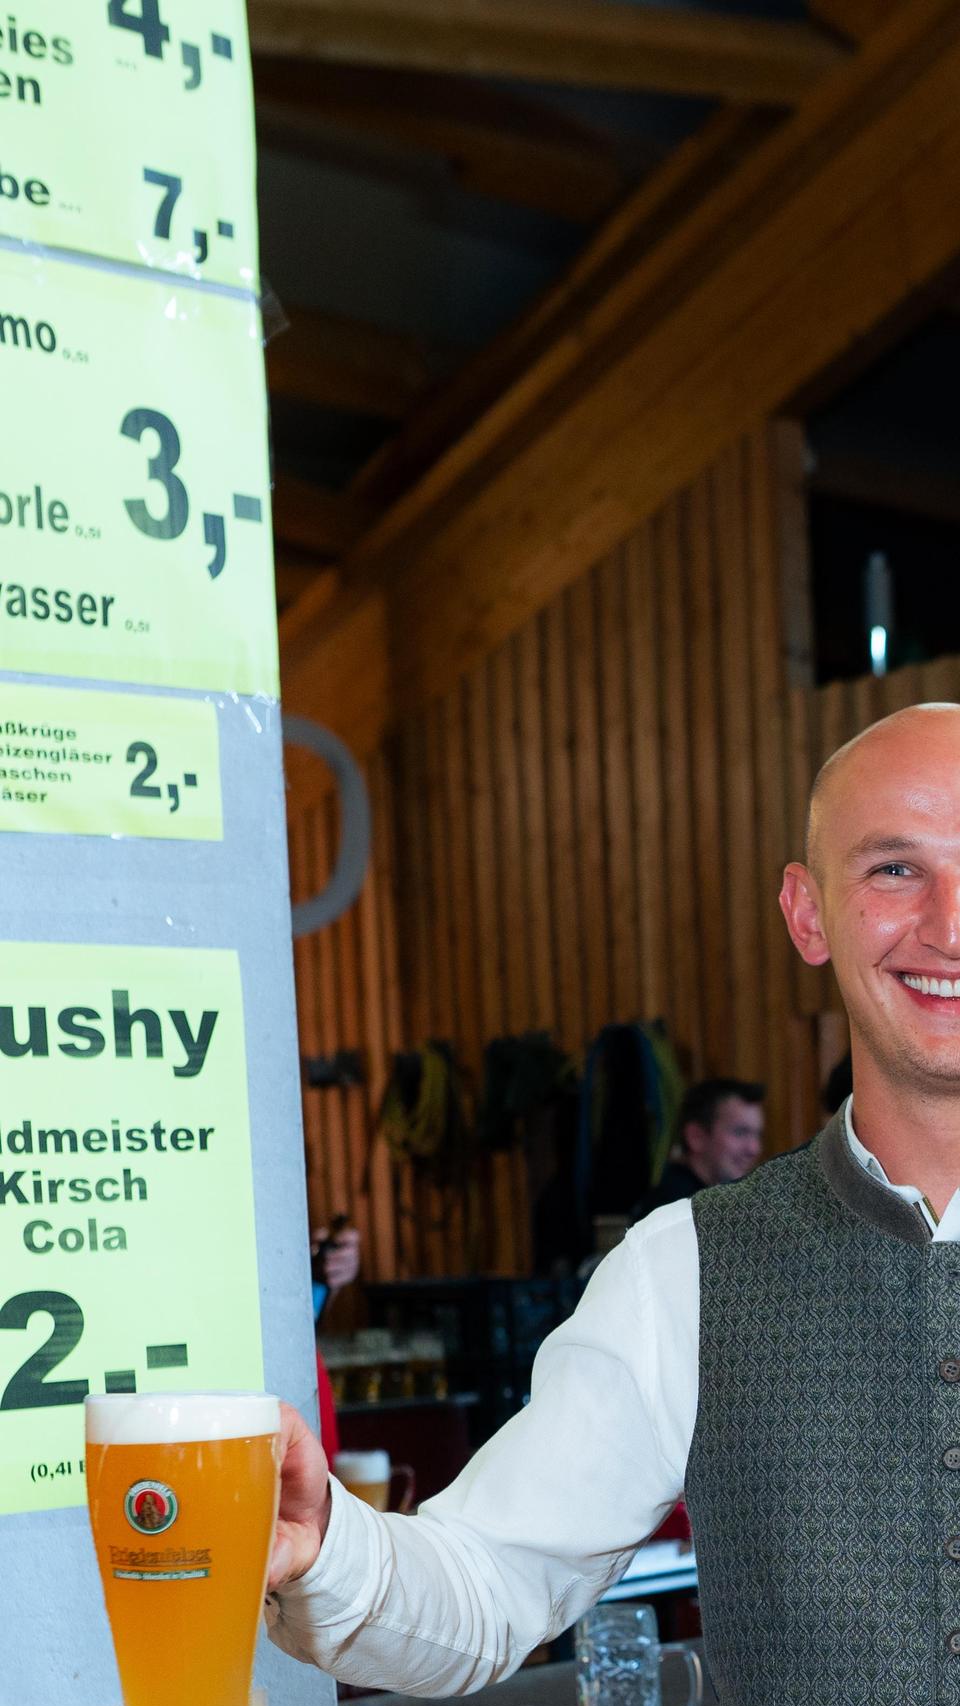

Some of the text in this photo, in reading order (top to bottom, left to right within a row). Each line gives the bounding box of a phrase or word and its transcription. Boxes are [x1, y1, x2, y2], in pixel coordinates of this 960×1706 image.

[0, 15, 73, 66] ies
[142, 166, 234, 264] 7,-
[119, 405, 263, 580] 3,-
[0, 583, 115, 627] asser
[0, 722, 76, 742] ßkrüge
[125, 741, 198, 813] 2,-
[0, 989, 219, 1079] ushy
[0, 1118, 215, 1154] dmeister
[0, 1168, 148, 1205] Kirsch
[23, 1218, 128, 1255] Cola
